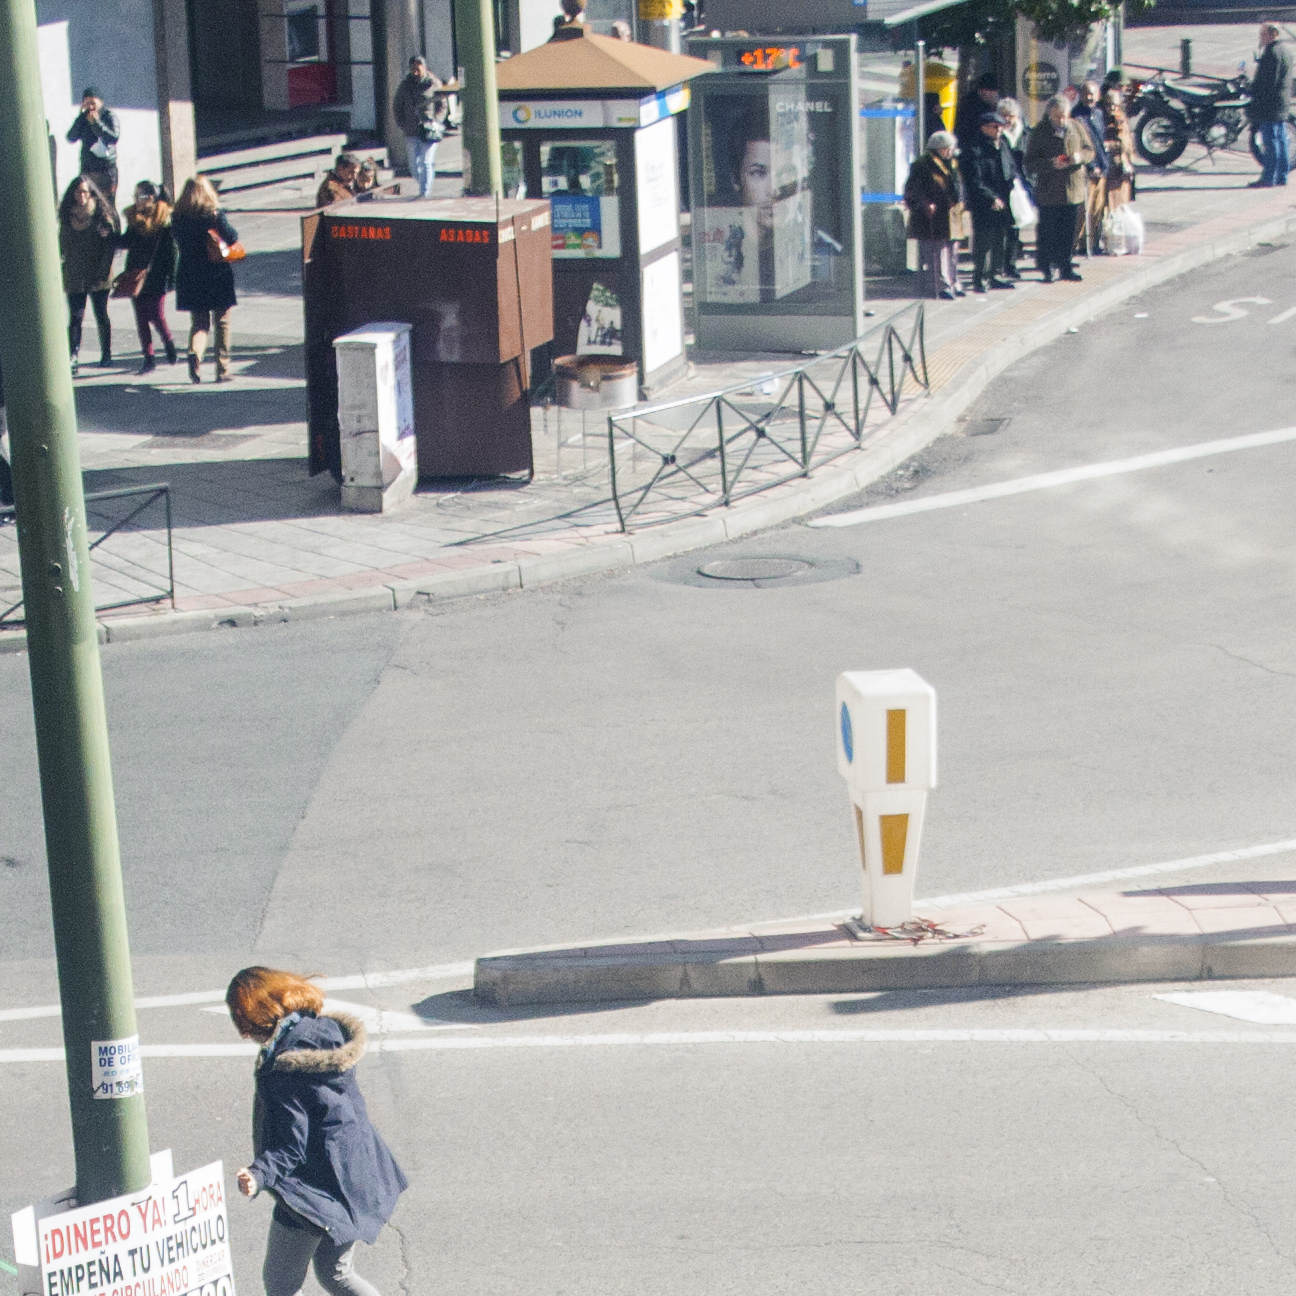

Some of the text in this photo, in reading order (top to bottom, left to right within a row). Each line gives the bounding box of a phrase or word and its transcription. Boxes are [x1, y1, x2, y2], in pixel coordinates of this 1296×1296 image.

[775, 101, 833, 113] CHANEL
[534, 108, 583, 120] ILUNION
[439, 228, 489, 242] ASADAS
[99, 1057, 114, 1067] DE
[44, 1180, 223, 1265] ¡DINERO YA! 1 HORA
[128, 1244, 151, 1277] TU
